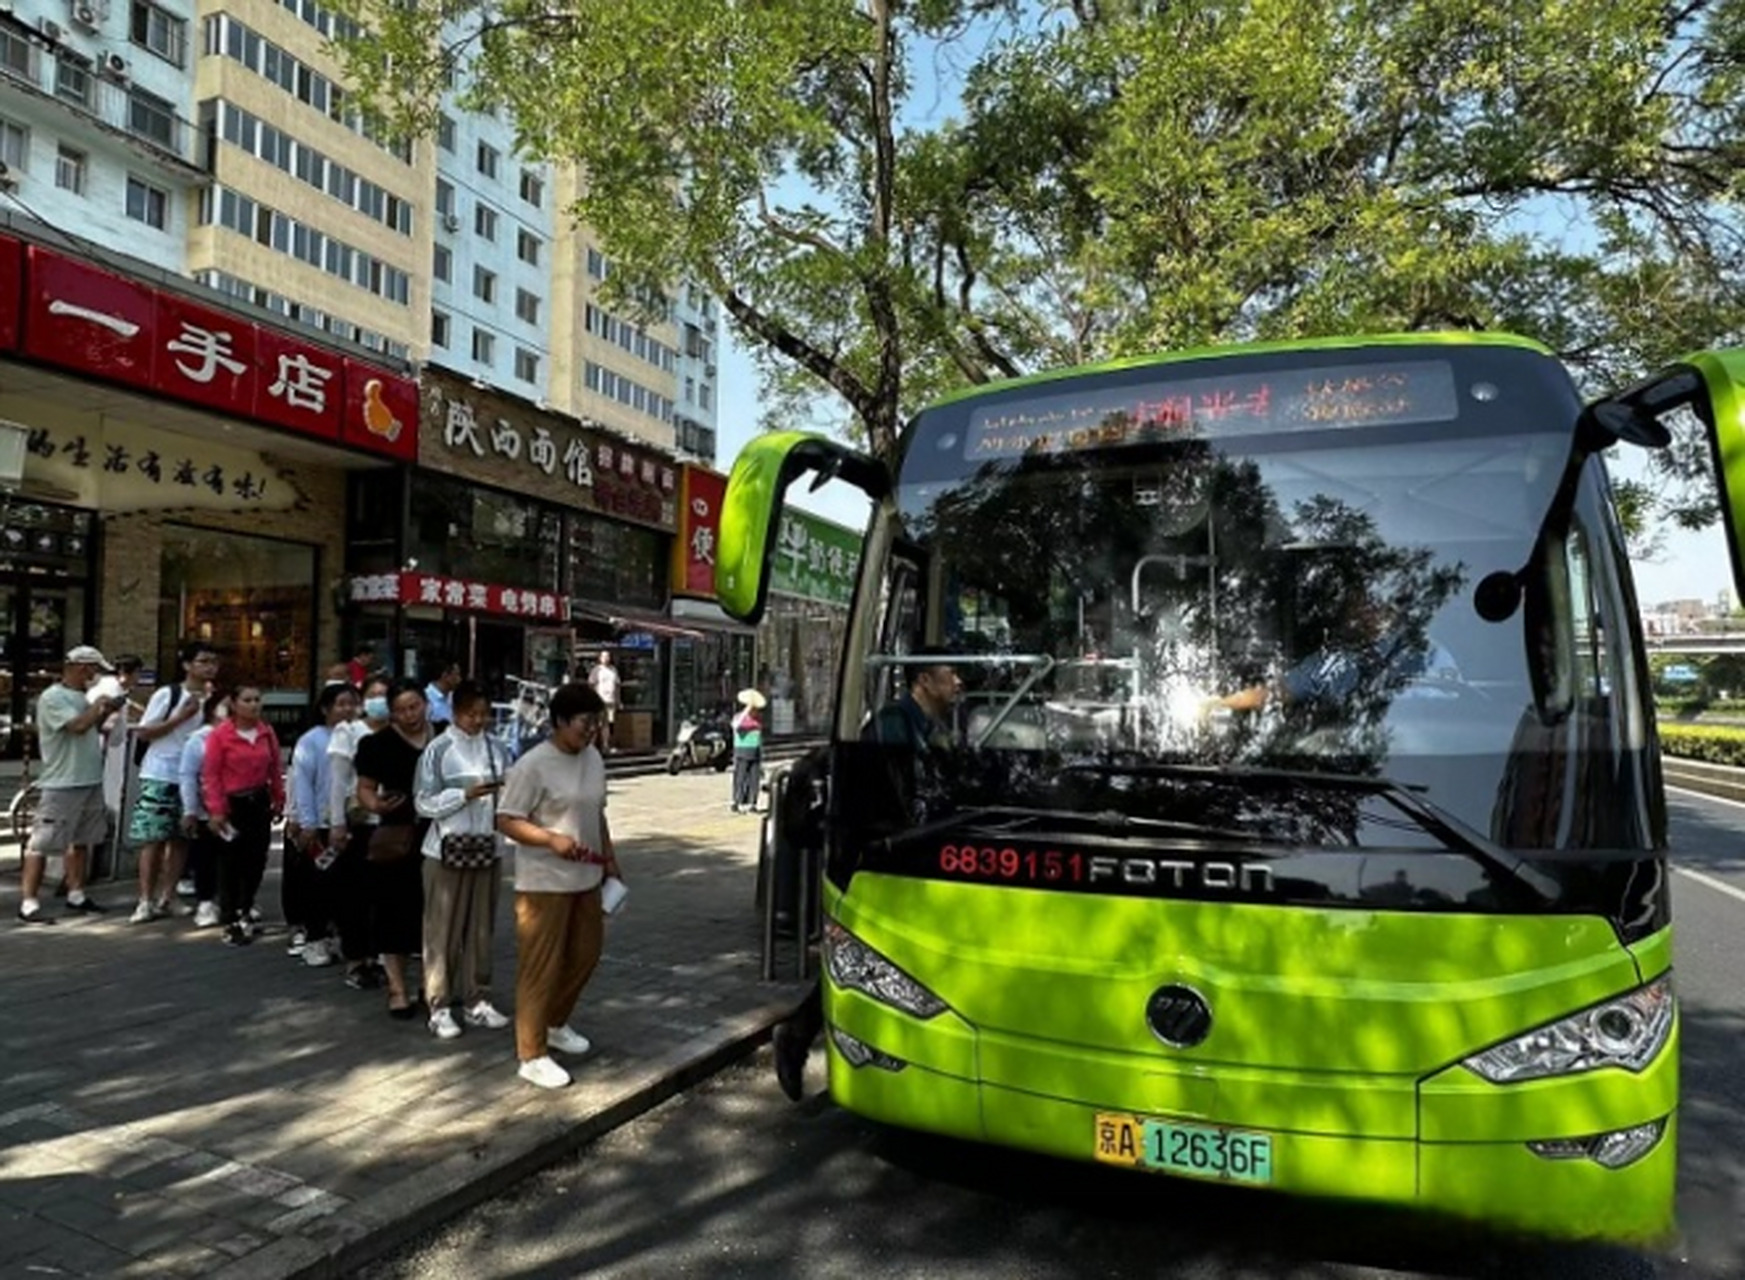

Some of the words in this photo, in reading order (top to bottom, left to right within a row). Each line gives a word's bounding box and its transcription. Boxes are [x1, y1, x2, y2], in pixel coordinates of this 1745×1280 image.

[49, 299, 333, 414] 一手店
[445, 400, 593, 487] 陕西面馆
[939, 845, 1082, 882] 6839151
[1089, 857, 1275, 892] FOTON
